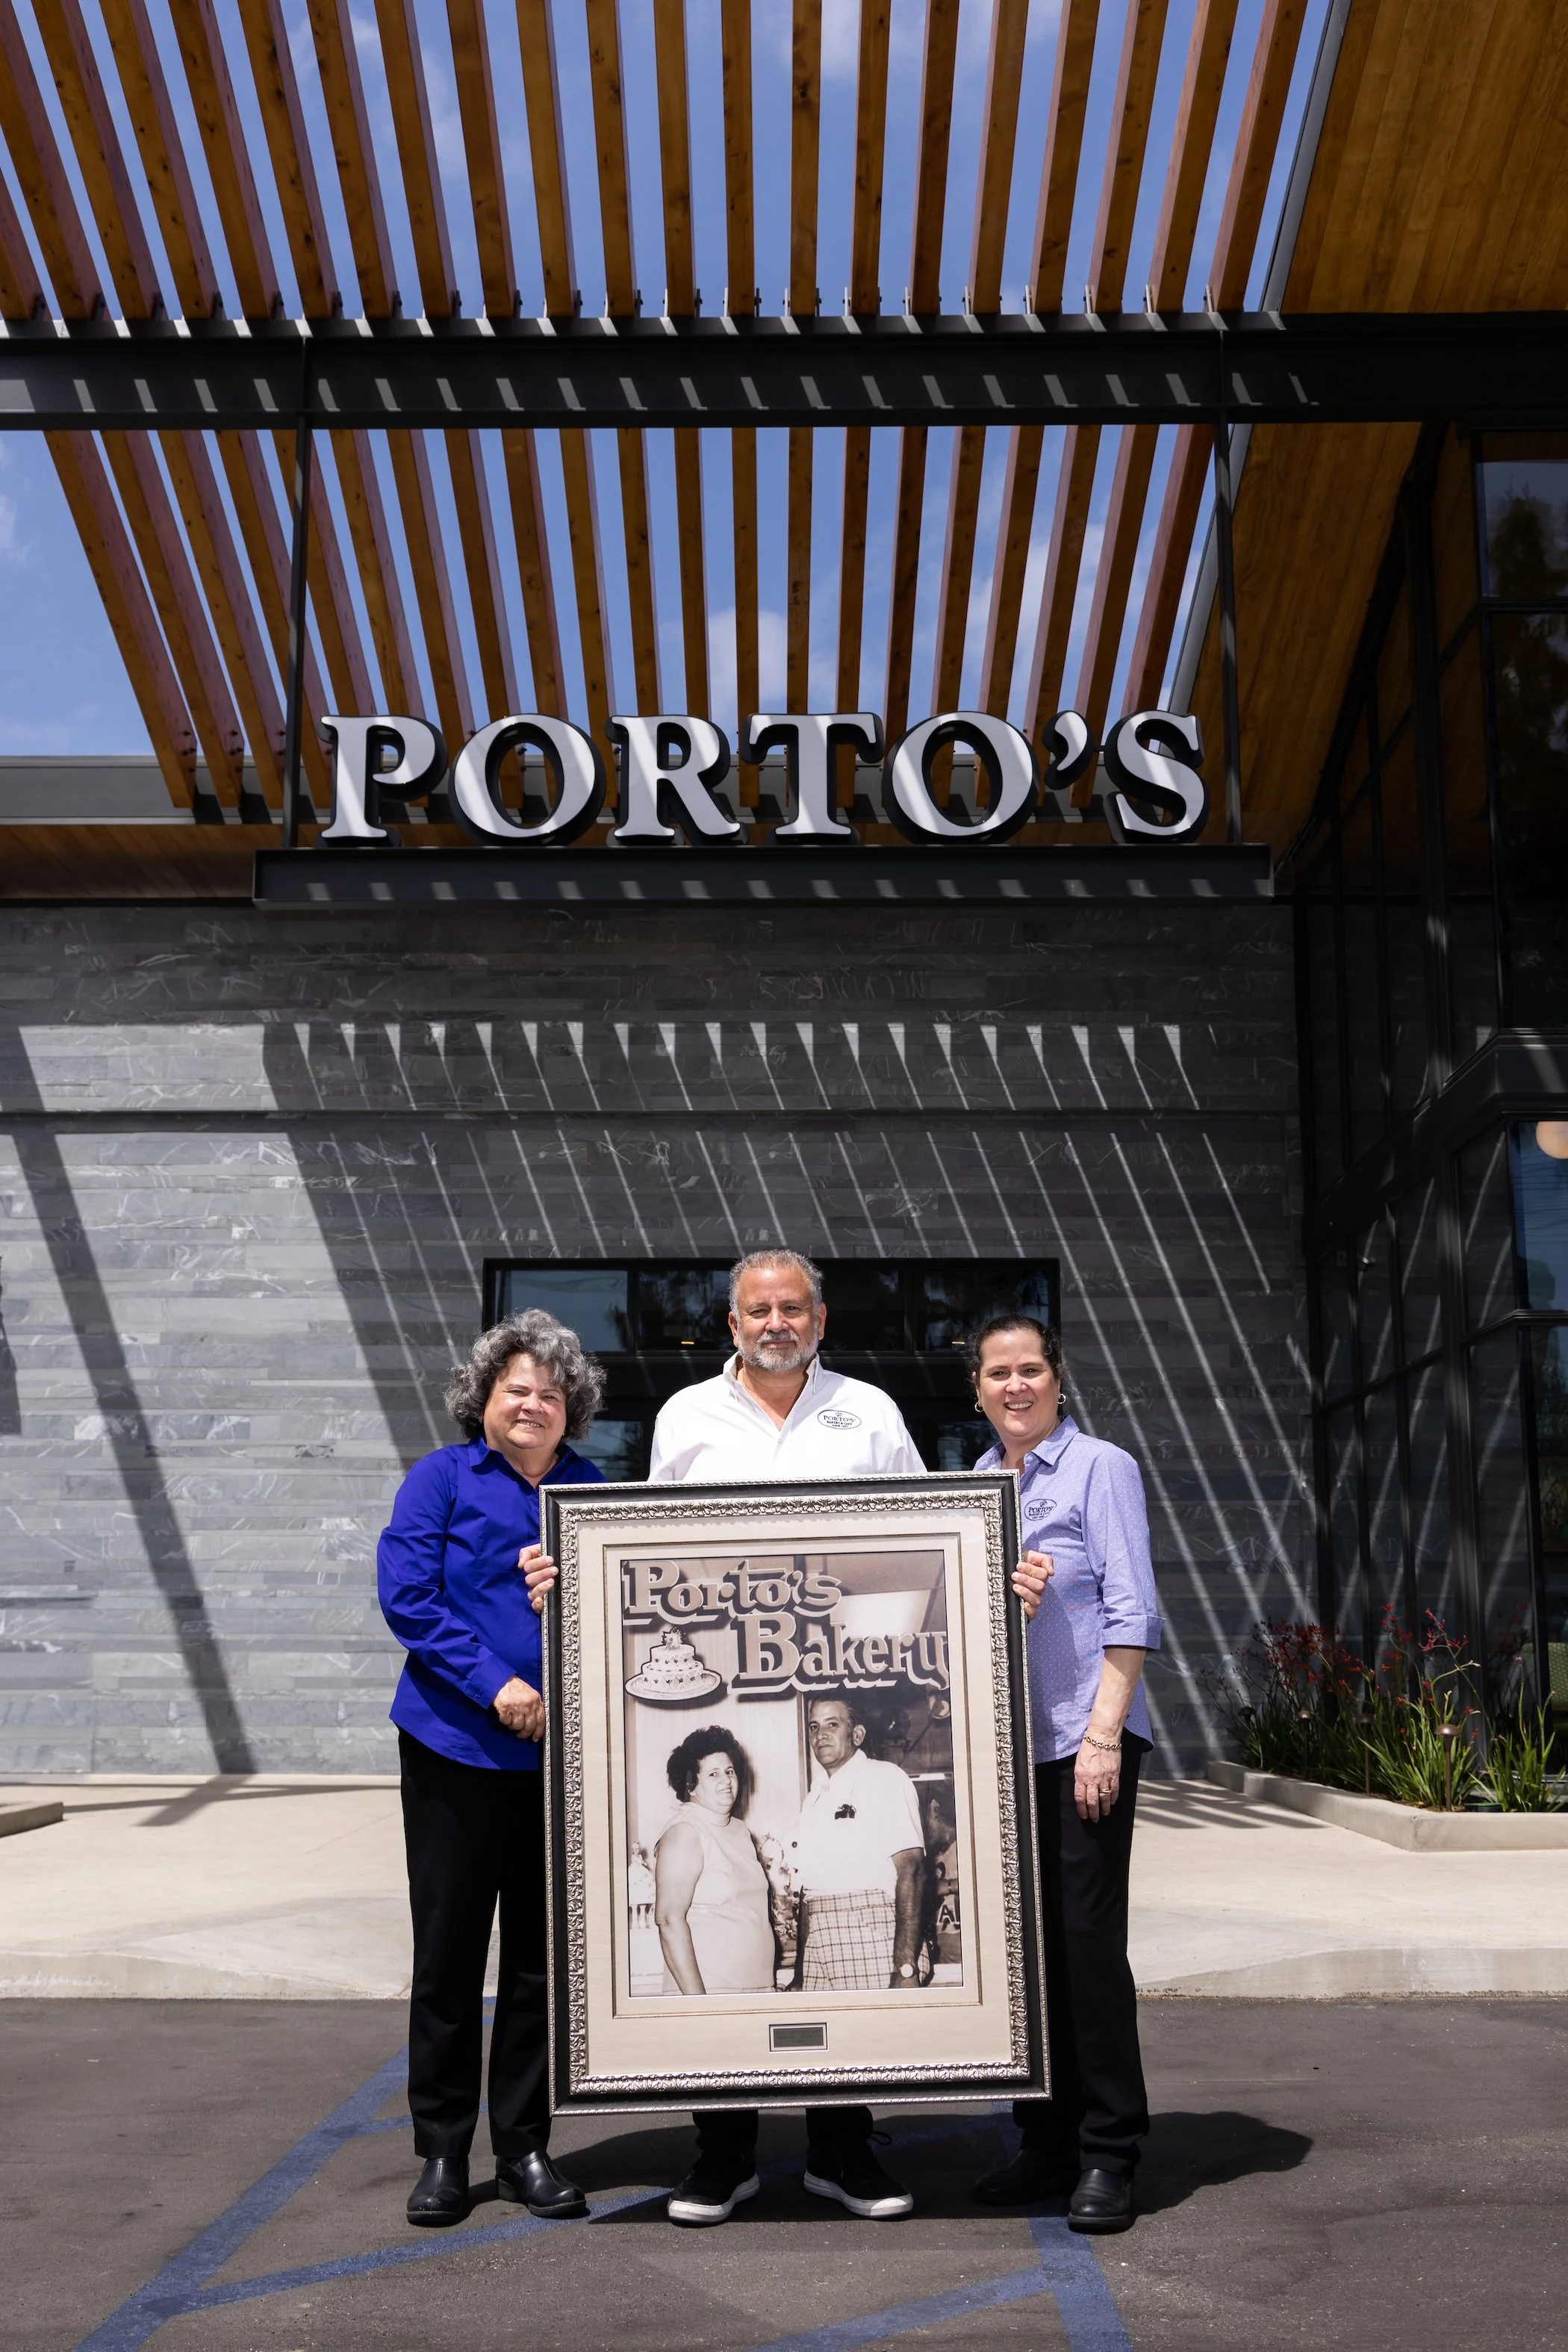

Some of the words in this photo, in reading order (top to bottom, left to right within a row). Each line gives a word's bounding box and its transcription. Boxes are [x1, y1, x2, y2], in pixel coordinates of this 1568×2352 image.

[320, 711, 1207, 844] PORTO'S
[622, 1560, 841, 1618] Porto's
[730, 1611, 949, 1689] Bakery
